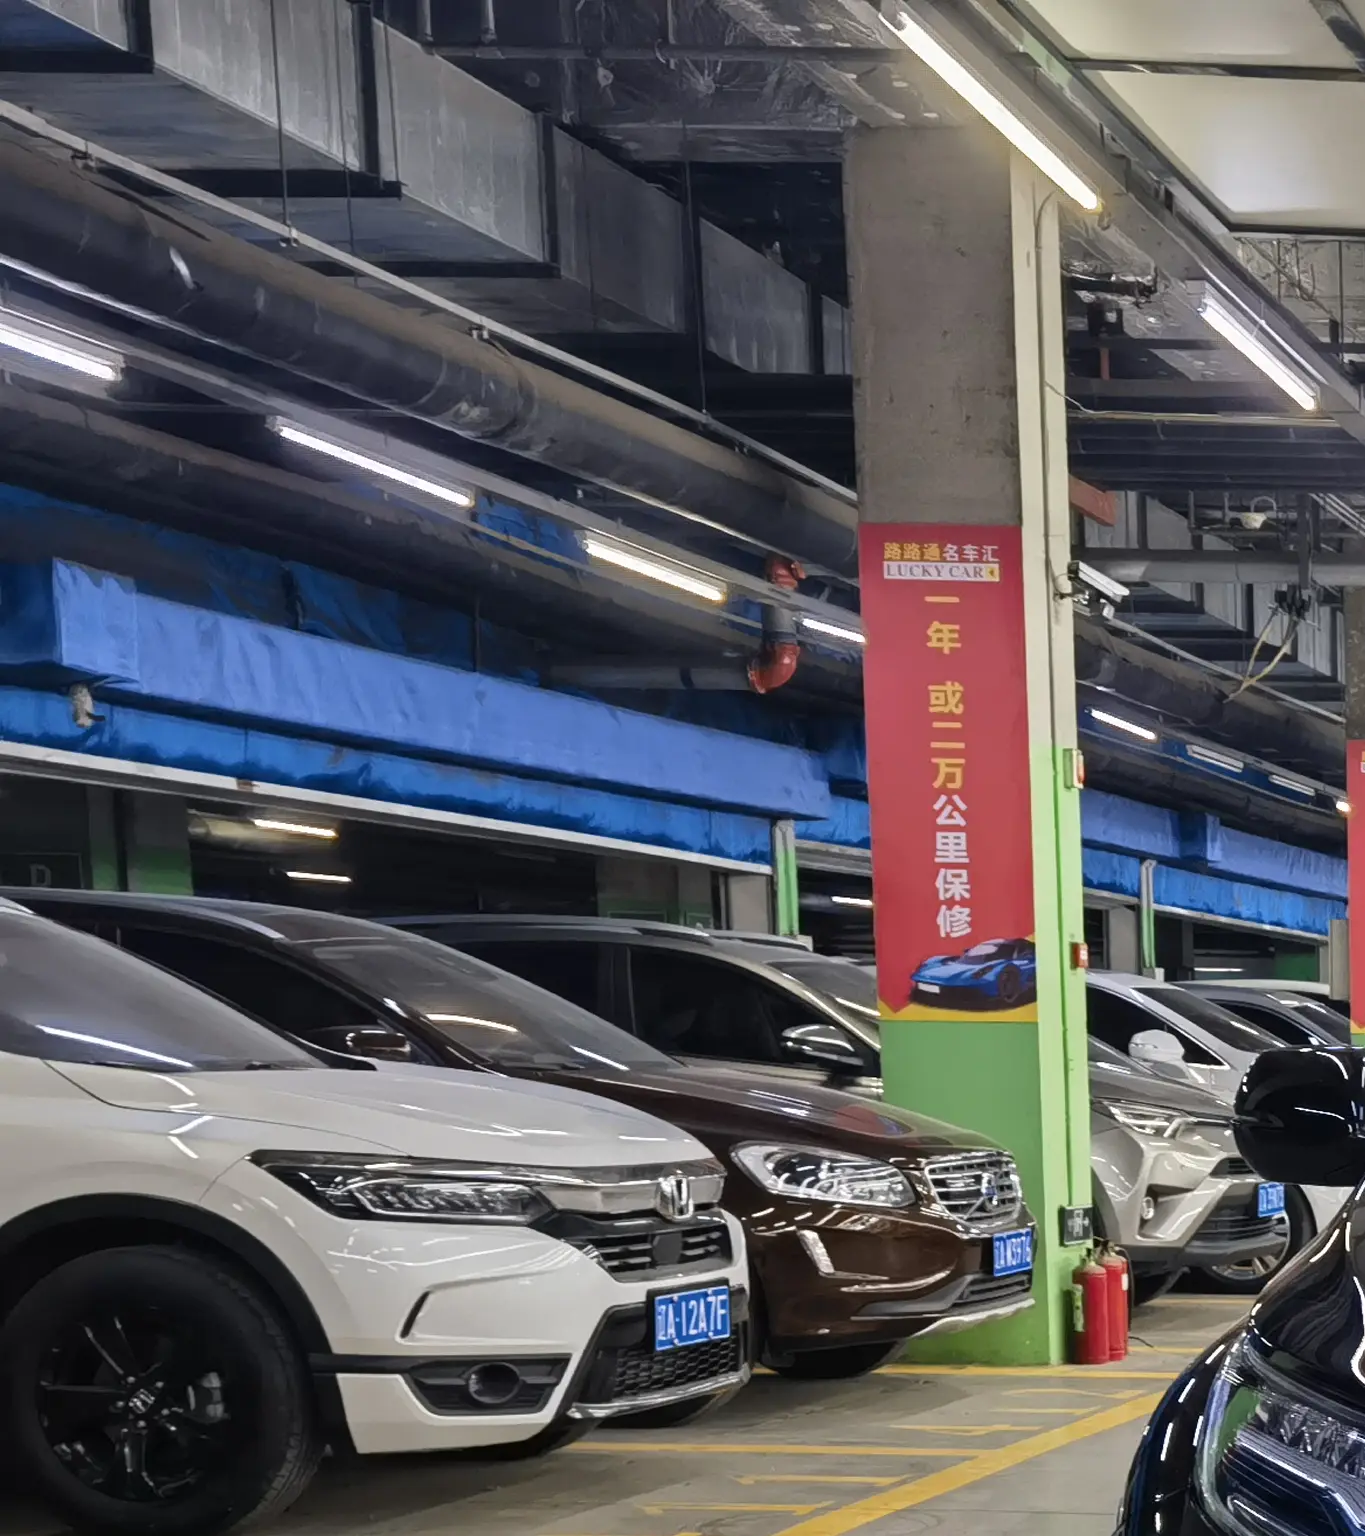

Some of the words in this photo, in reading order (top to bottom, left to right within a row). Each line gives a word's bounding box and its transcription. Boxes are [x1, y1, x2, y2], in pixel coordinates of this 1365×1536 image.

[884, 542, 999, 561] 路路通名车汇
[886, 564, 943, 577] LUCKY
[949, 566, 984, 578] CAR
[924, 596, 962, 654] 一年
[928, 681, 972, 937] 或二万公里保修
